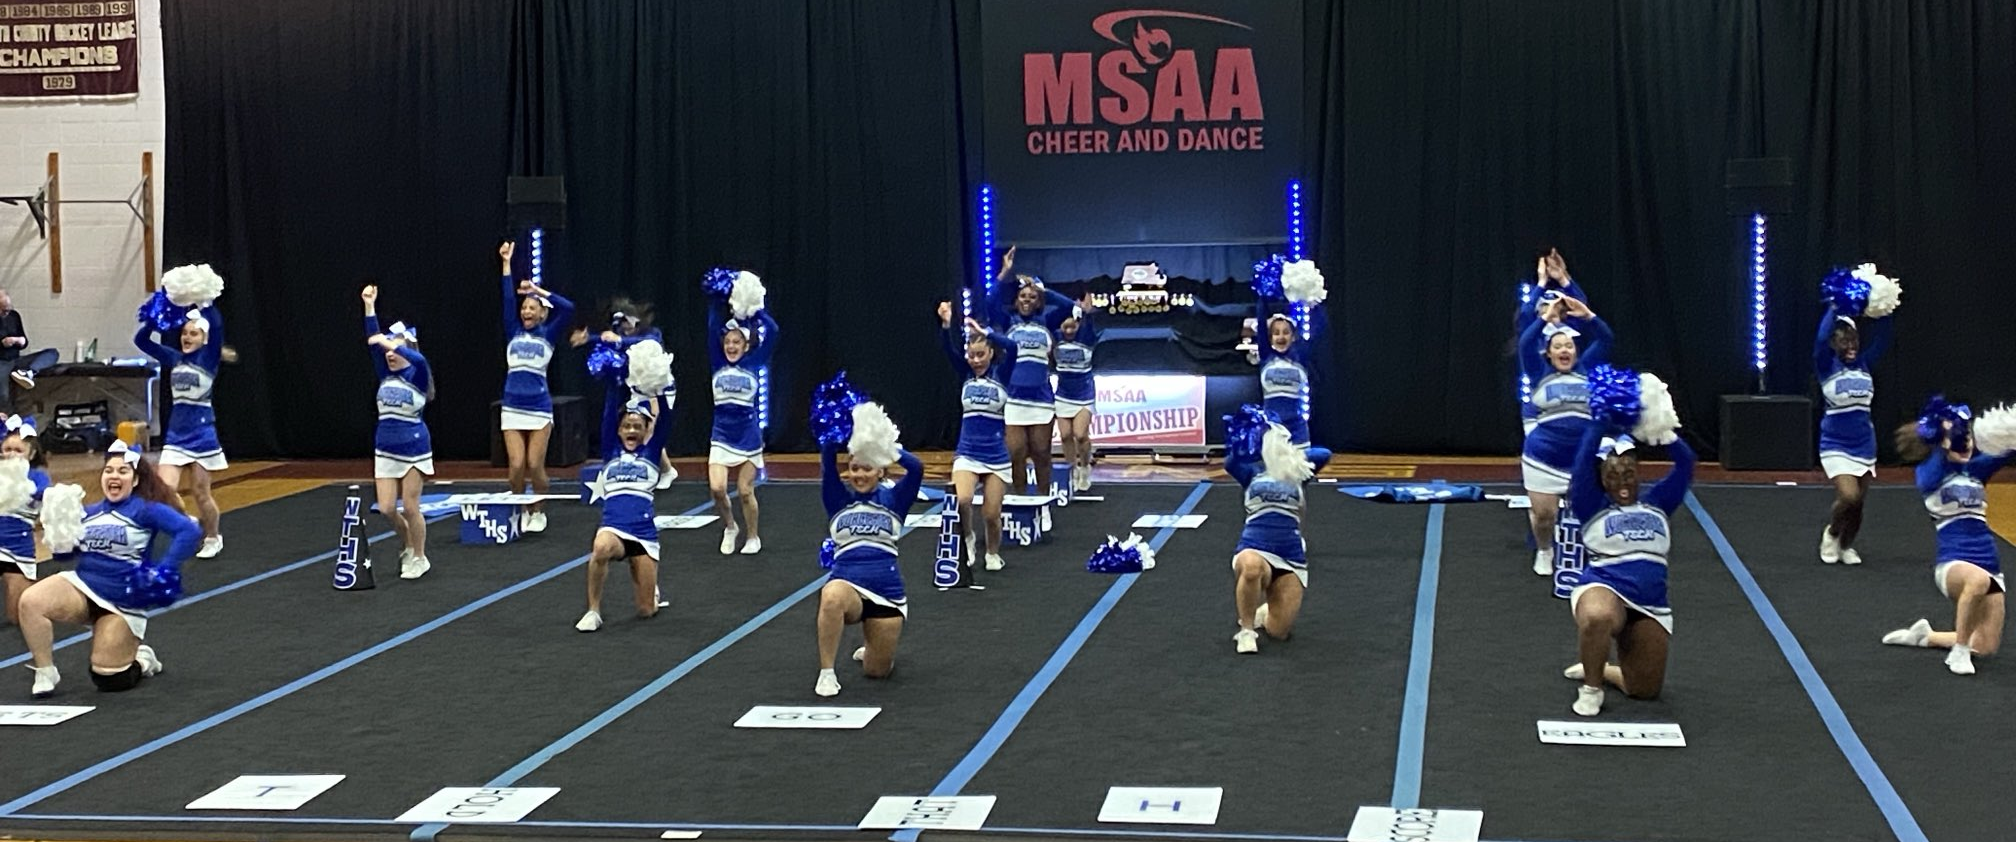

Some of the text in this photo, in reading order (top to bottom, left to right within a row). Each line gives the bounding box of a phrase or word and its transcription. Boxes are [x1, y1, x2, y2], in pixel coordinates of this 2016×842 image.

[0, 45, 118, 67] CHAMPIONS
[1024, 47, 1265, 125] MSAA
[1027, 126, 1265, 154] CHEER AND DANCE
[1097, 389, 1148, 403] MSAA
[771, 712, 842, 721] GO
[256, 785, 294, 798] T
[1139, 800, 1181, 811] H
